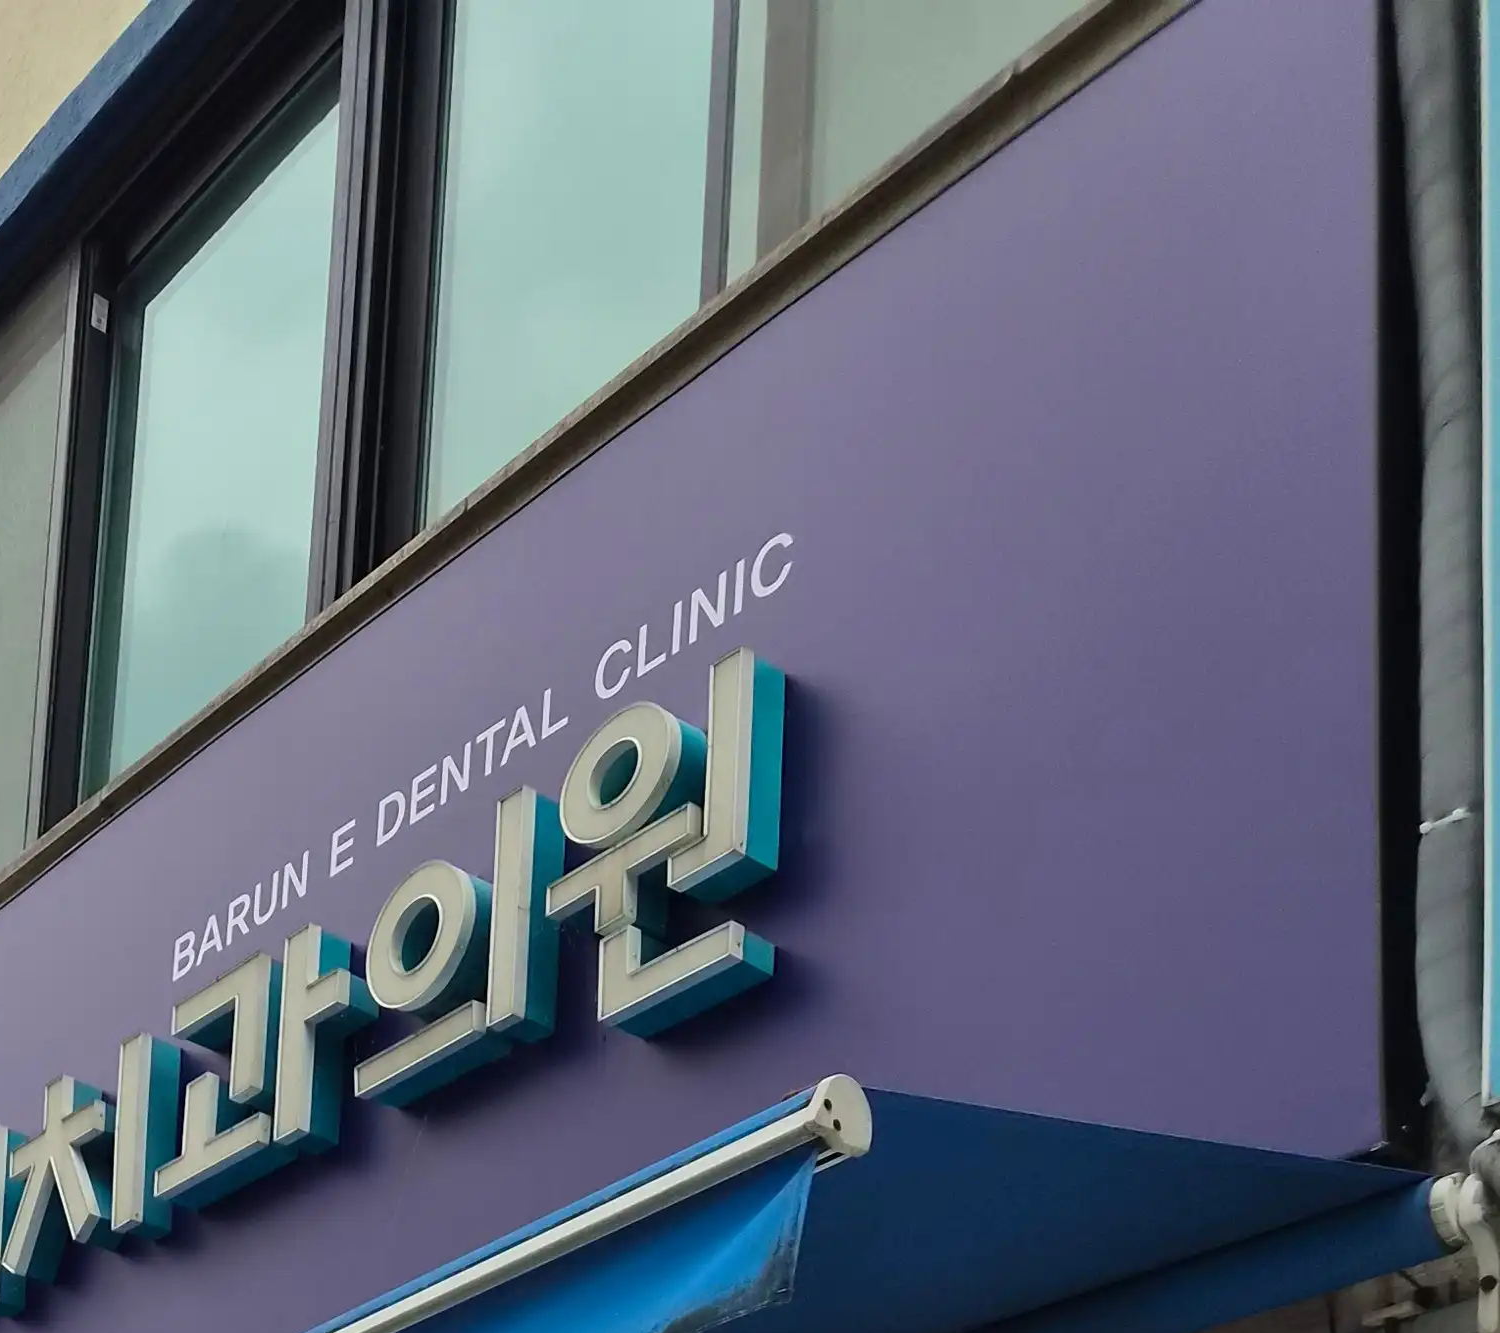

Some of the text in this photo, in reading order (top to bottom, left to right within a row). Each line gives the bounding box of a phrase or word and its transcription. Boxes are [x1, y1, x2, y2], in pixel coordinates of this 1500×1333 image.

[171, 532, 794, 983] BARUN E DENTAL CLINIC
